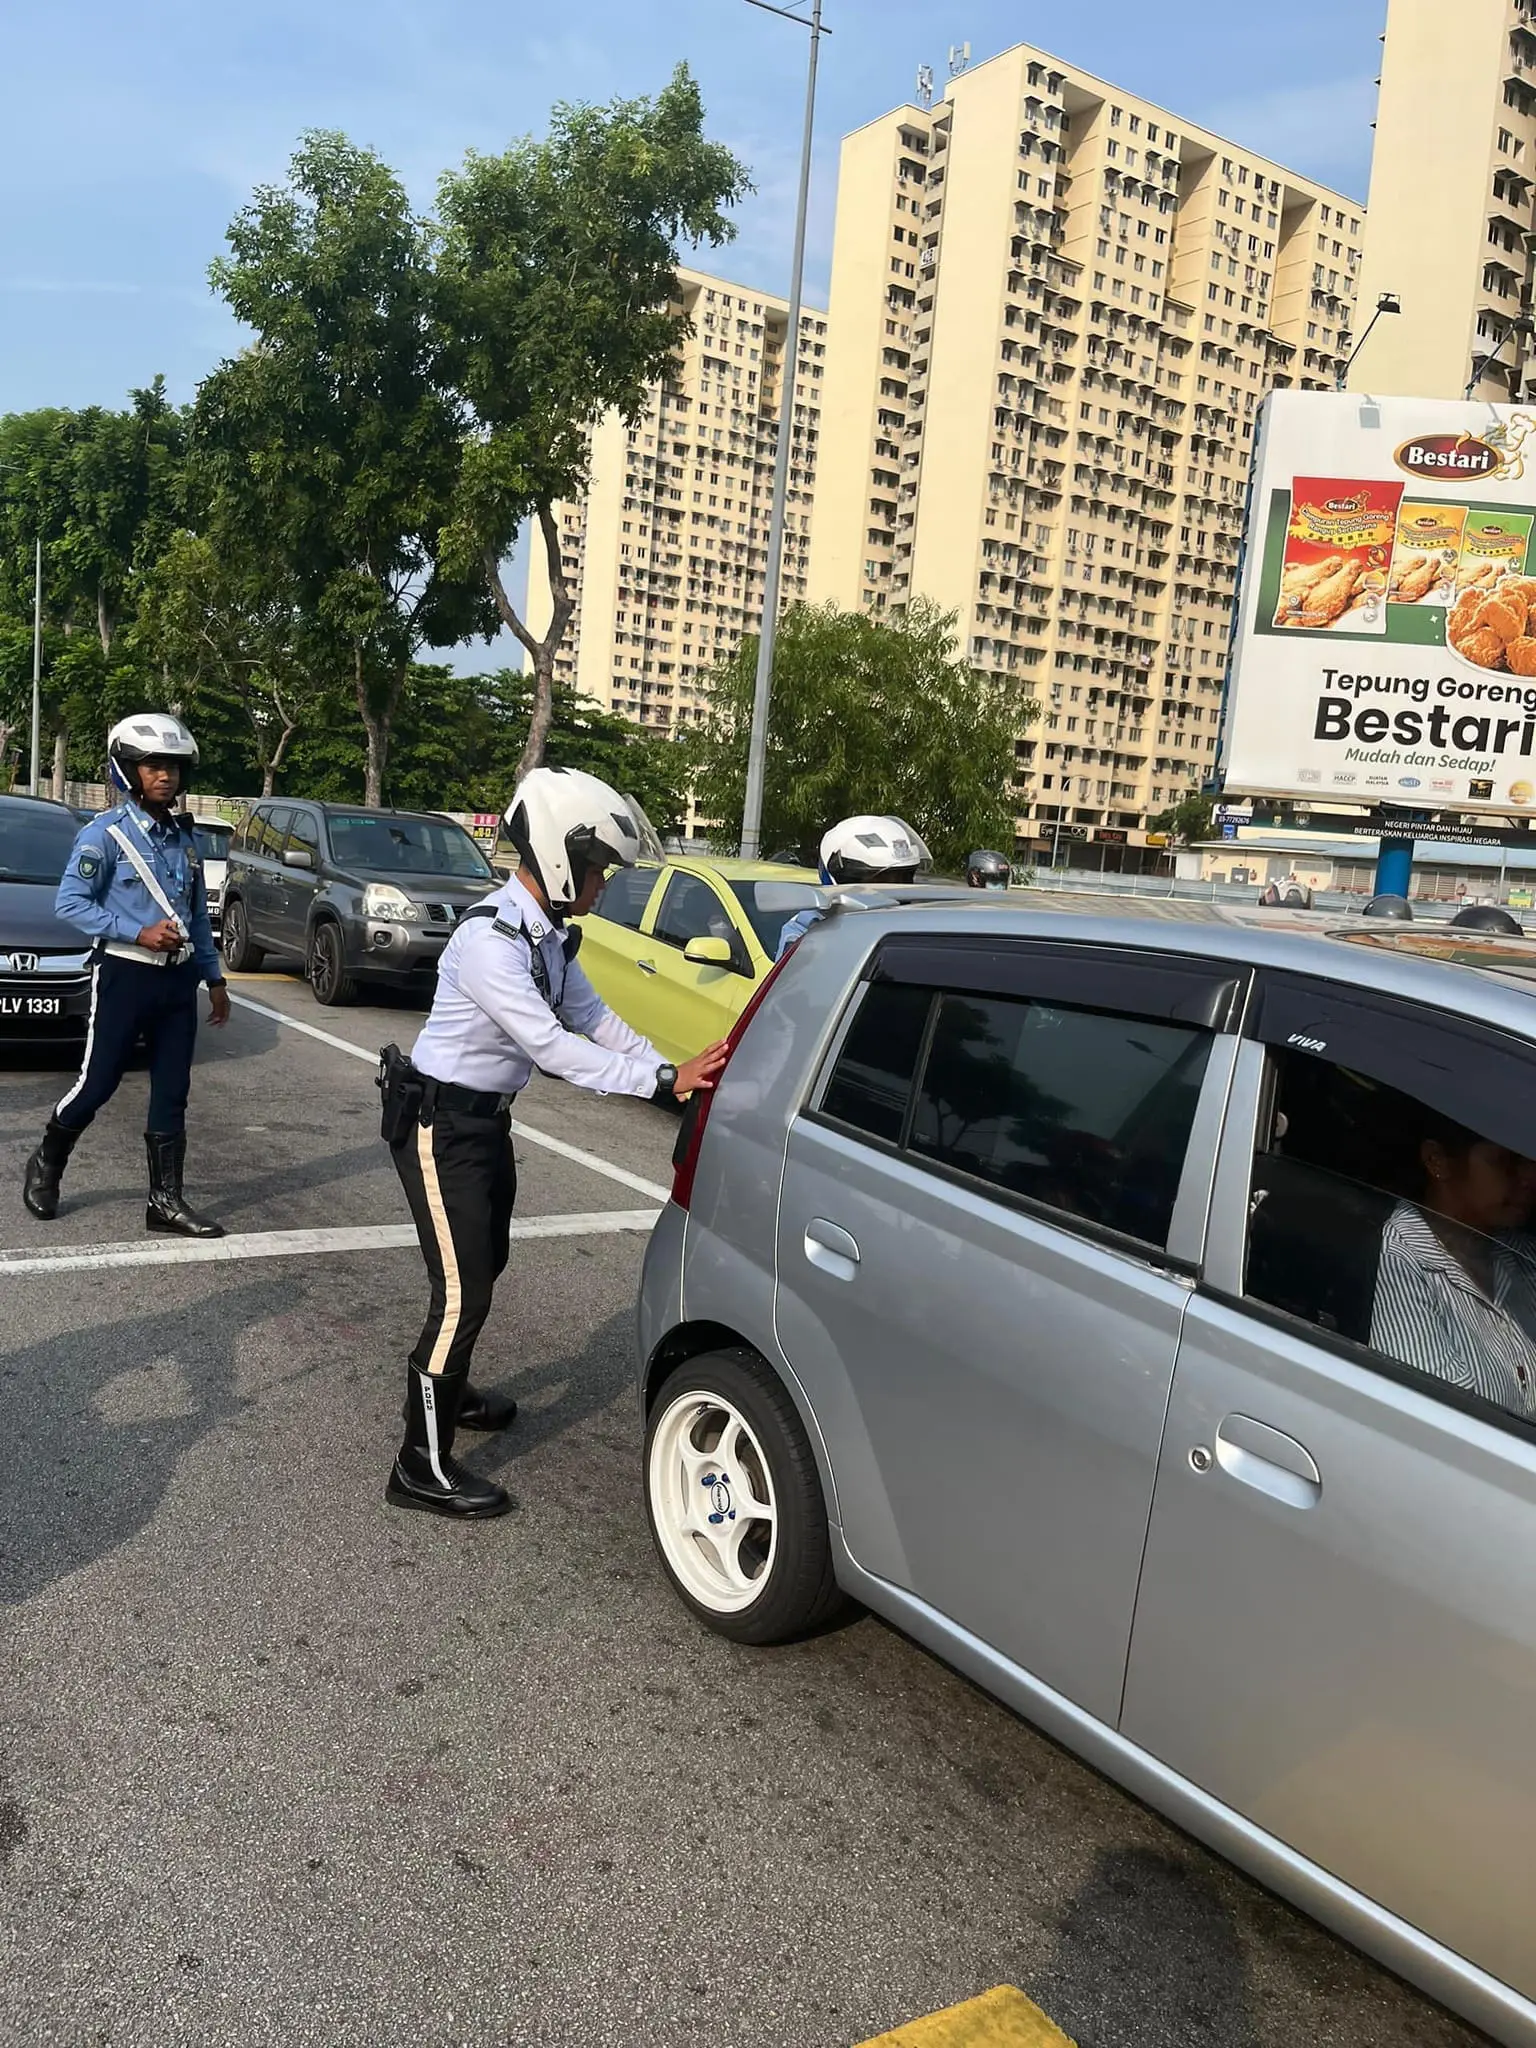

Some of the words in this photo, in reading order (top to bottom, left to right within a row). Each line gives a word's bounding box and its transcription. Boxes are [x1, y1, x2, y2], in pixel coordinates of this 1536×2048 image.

[1407, 446, 1489, 469] Bestari
[1322, 668, 1430, 703] Tepung
[1436, 677, 1536, 712] Goreng
[1314, 696, 1536, 756] Bestari
[1344, 748, 1400, 764] Mudah
[1403, 751, 1436, 767] dan
[1438, 754, 1496, 775] Sedap!
[1354, 827, 1402, 838] BERTERASKAN
[1403, 831, 1438, 841] KELUARGA
[1439, 835, 1473, 844] INSPIRASI
[1474, 838, 1501, 846] NEGARA
[1384, 820, 1410, 829] NEGERI
[1411, 823, 1436, 832] PINTAR
[1436, 825, 1451, 833] DAN
[1452, 826, 1473, 834] HIJAU
[26, 998, 60, 1014] 1331
[1287, 1033, 1327, 1053] VIVA
